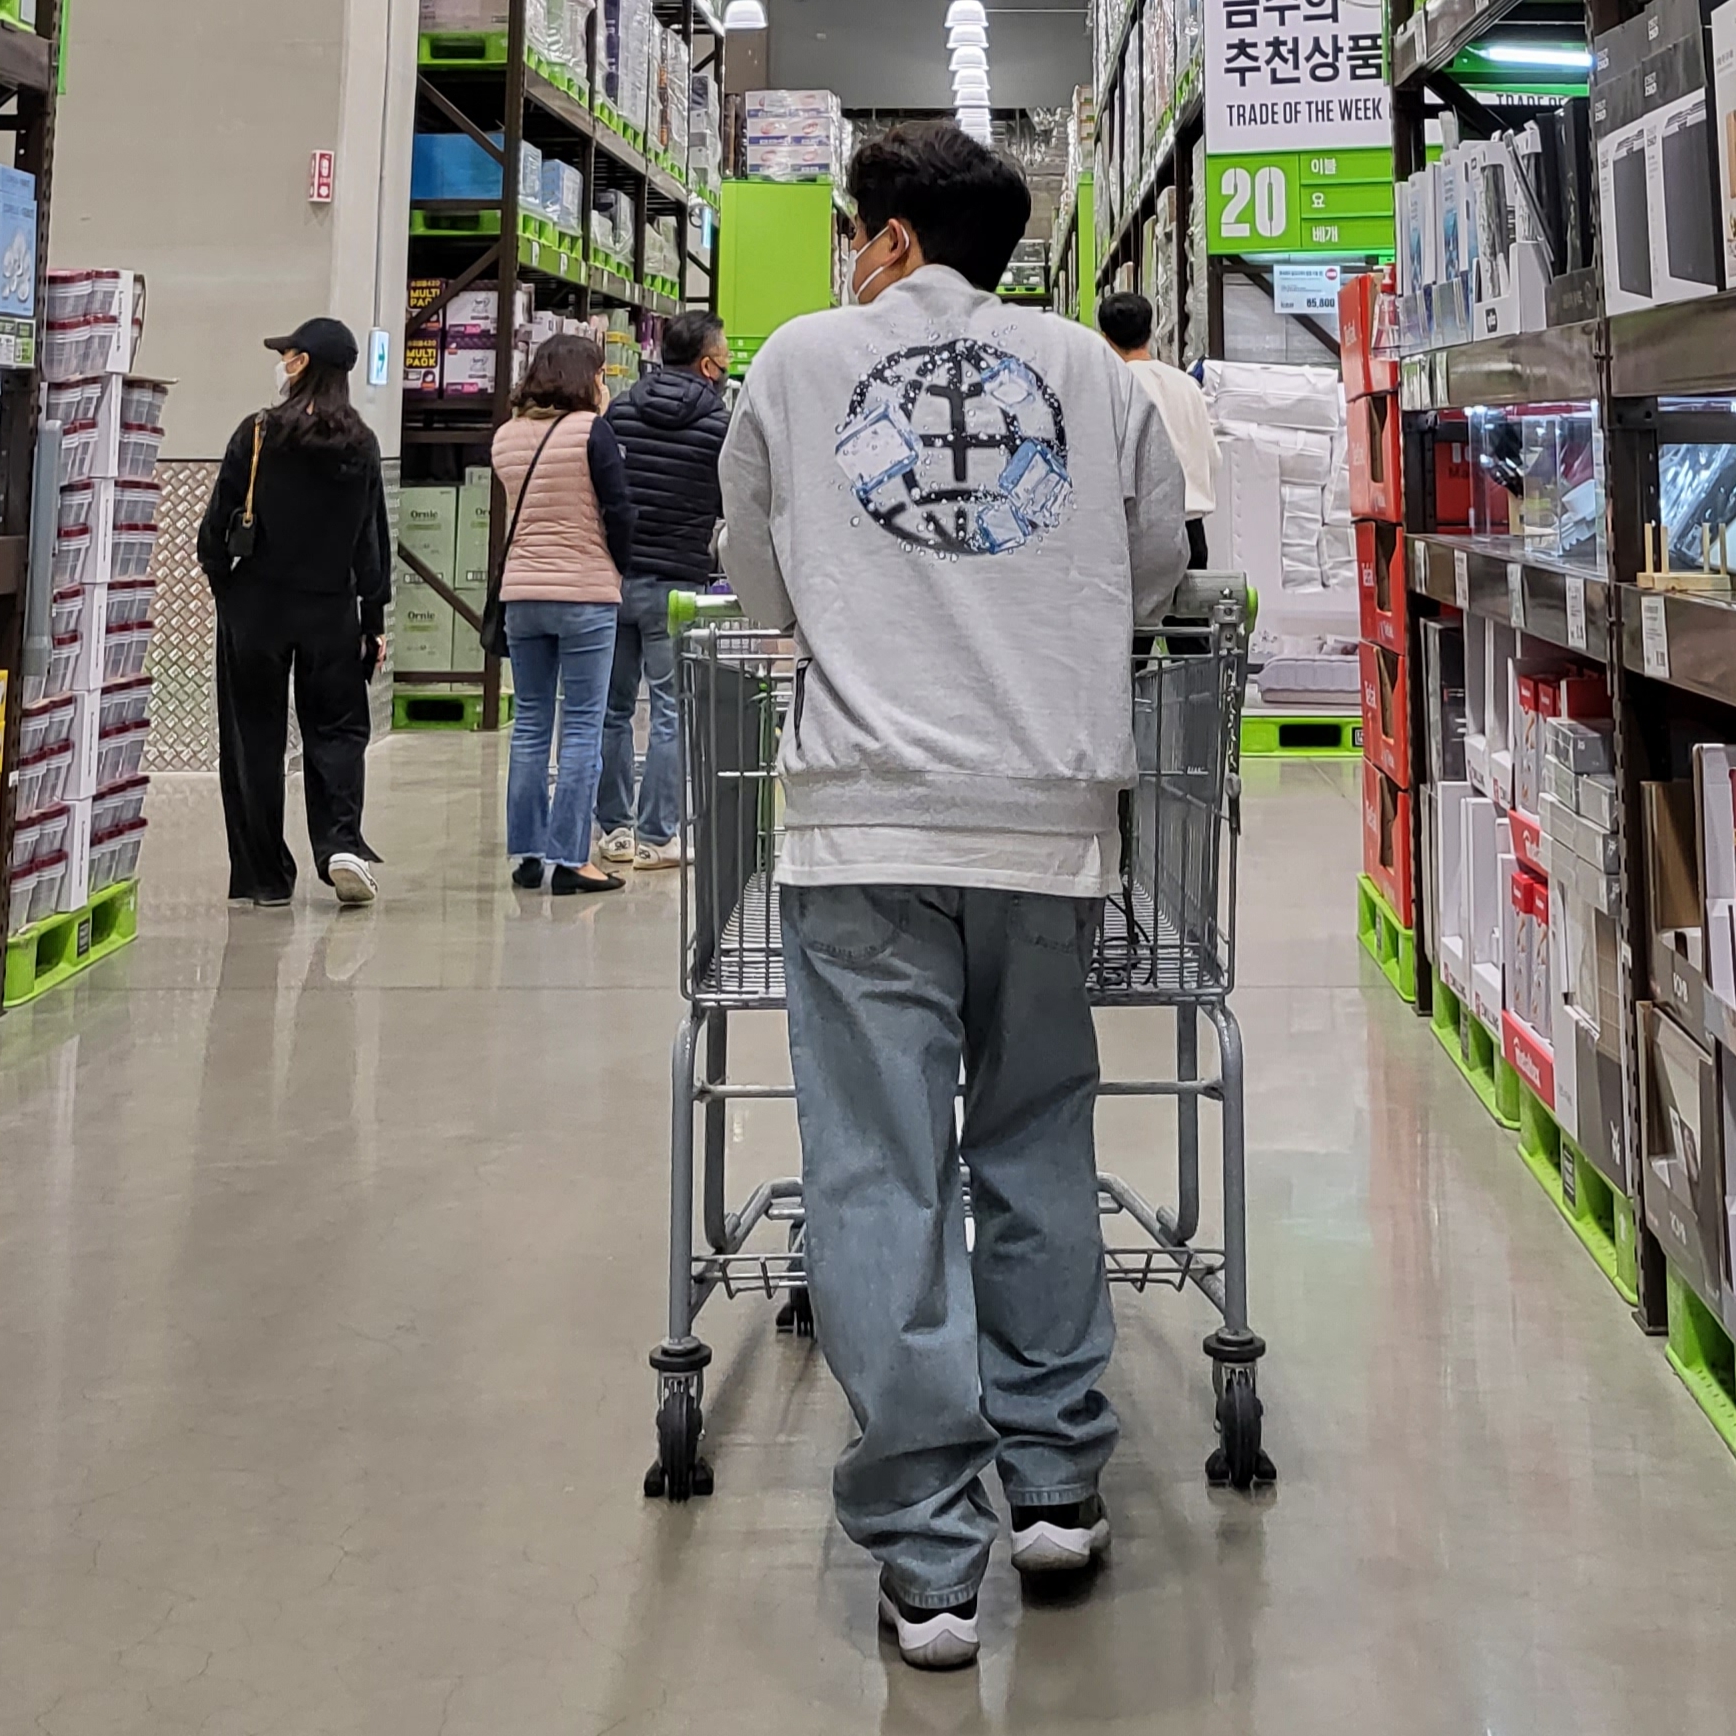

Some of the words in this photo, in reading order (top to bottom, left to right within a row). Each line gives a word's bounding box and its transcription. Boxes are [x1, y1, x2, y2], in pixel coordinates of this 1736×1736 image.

[1224, 33, 1383, 87] 추천상품
[1226, 102, 1279, 127] TRADE
[1283, 101, 1302, 124] OF
[1305, 99, 1334, 123] THE
[1339, 97, 1383, 122] WEEK
[1220, 166, 1287, 238] 20
[1311, 192, 1326, 208] 요
[1312, 225, 1338, 243] 베개
[406, 348, 437, 358] MULTI
[406, 357, 437, 367] PACK
